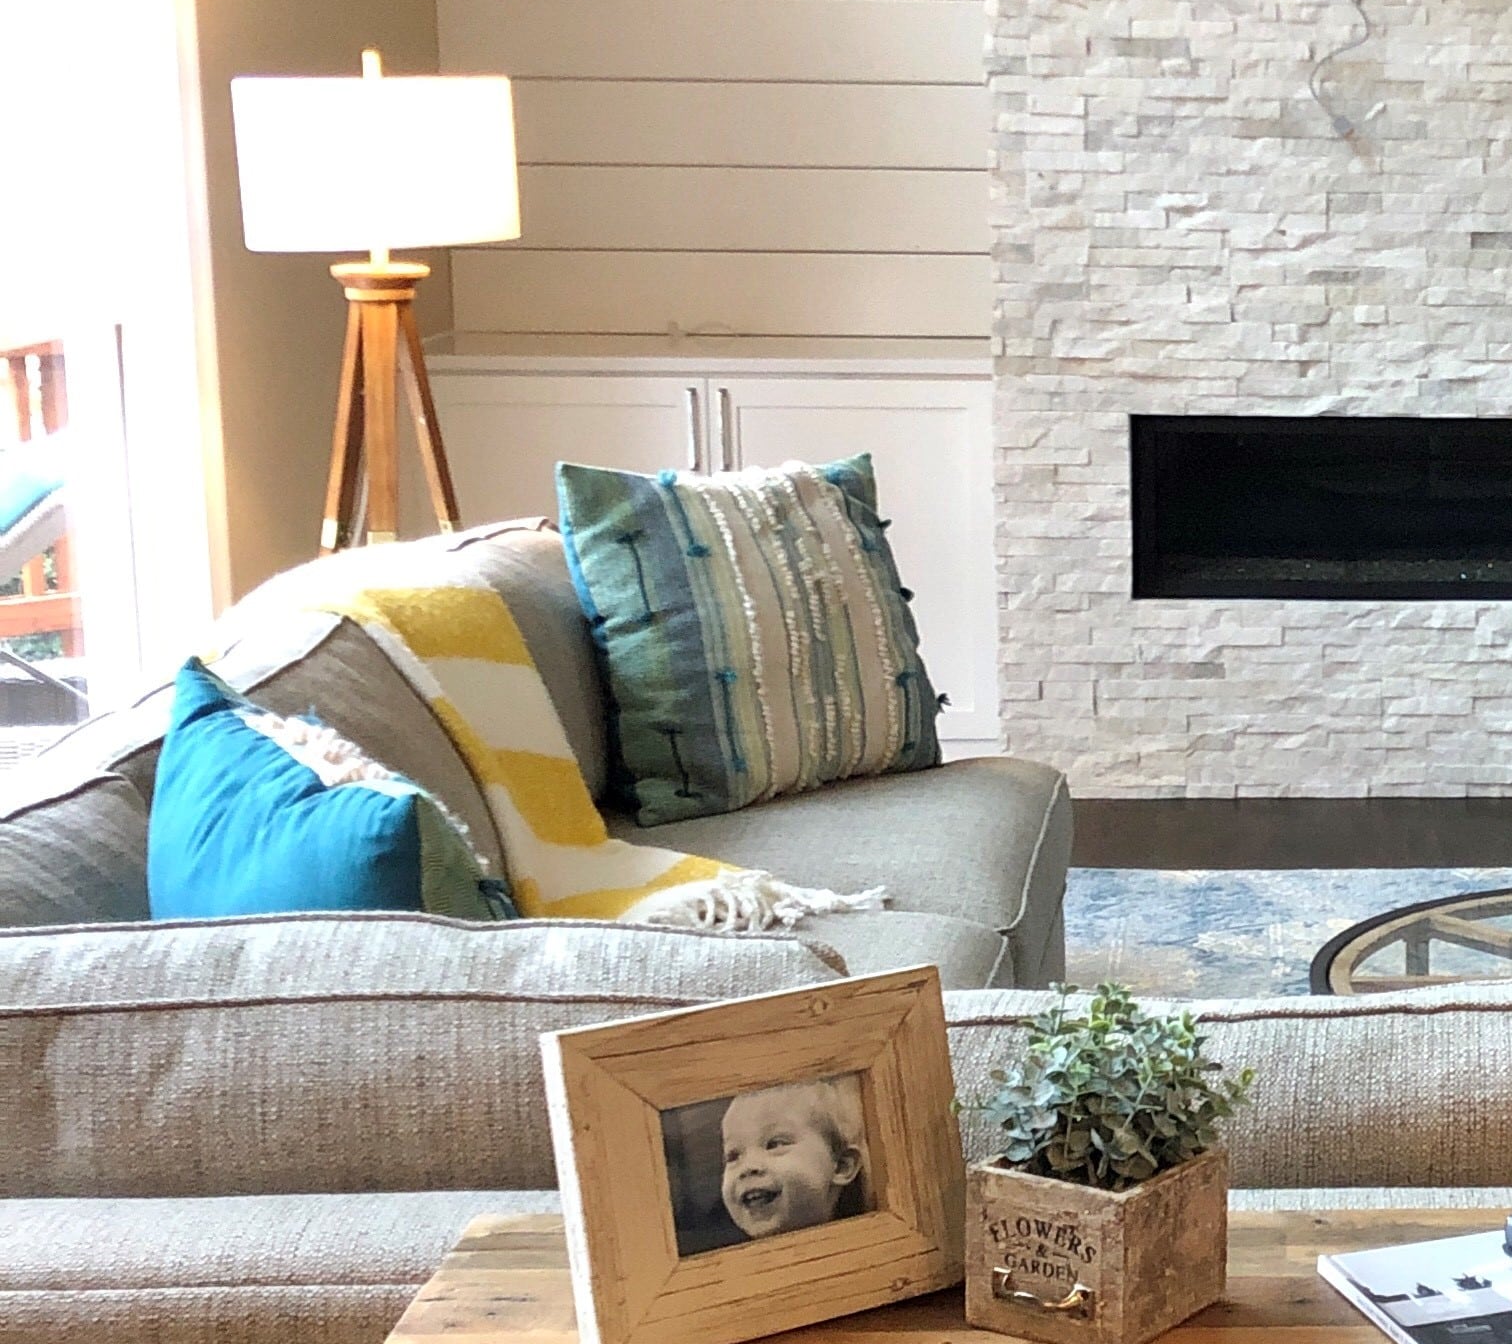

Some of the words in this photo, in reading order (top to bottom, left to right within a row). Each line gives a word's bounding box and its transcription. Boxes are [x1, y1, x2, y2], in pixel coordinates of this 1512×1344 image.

[989, 1216, 1097, 1263] FLOWERS
[1036, 1243, 1048, 1258] &
[1004, 1253, 1078, 1283] GARDEN
